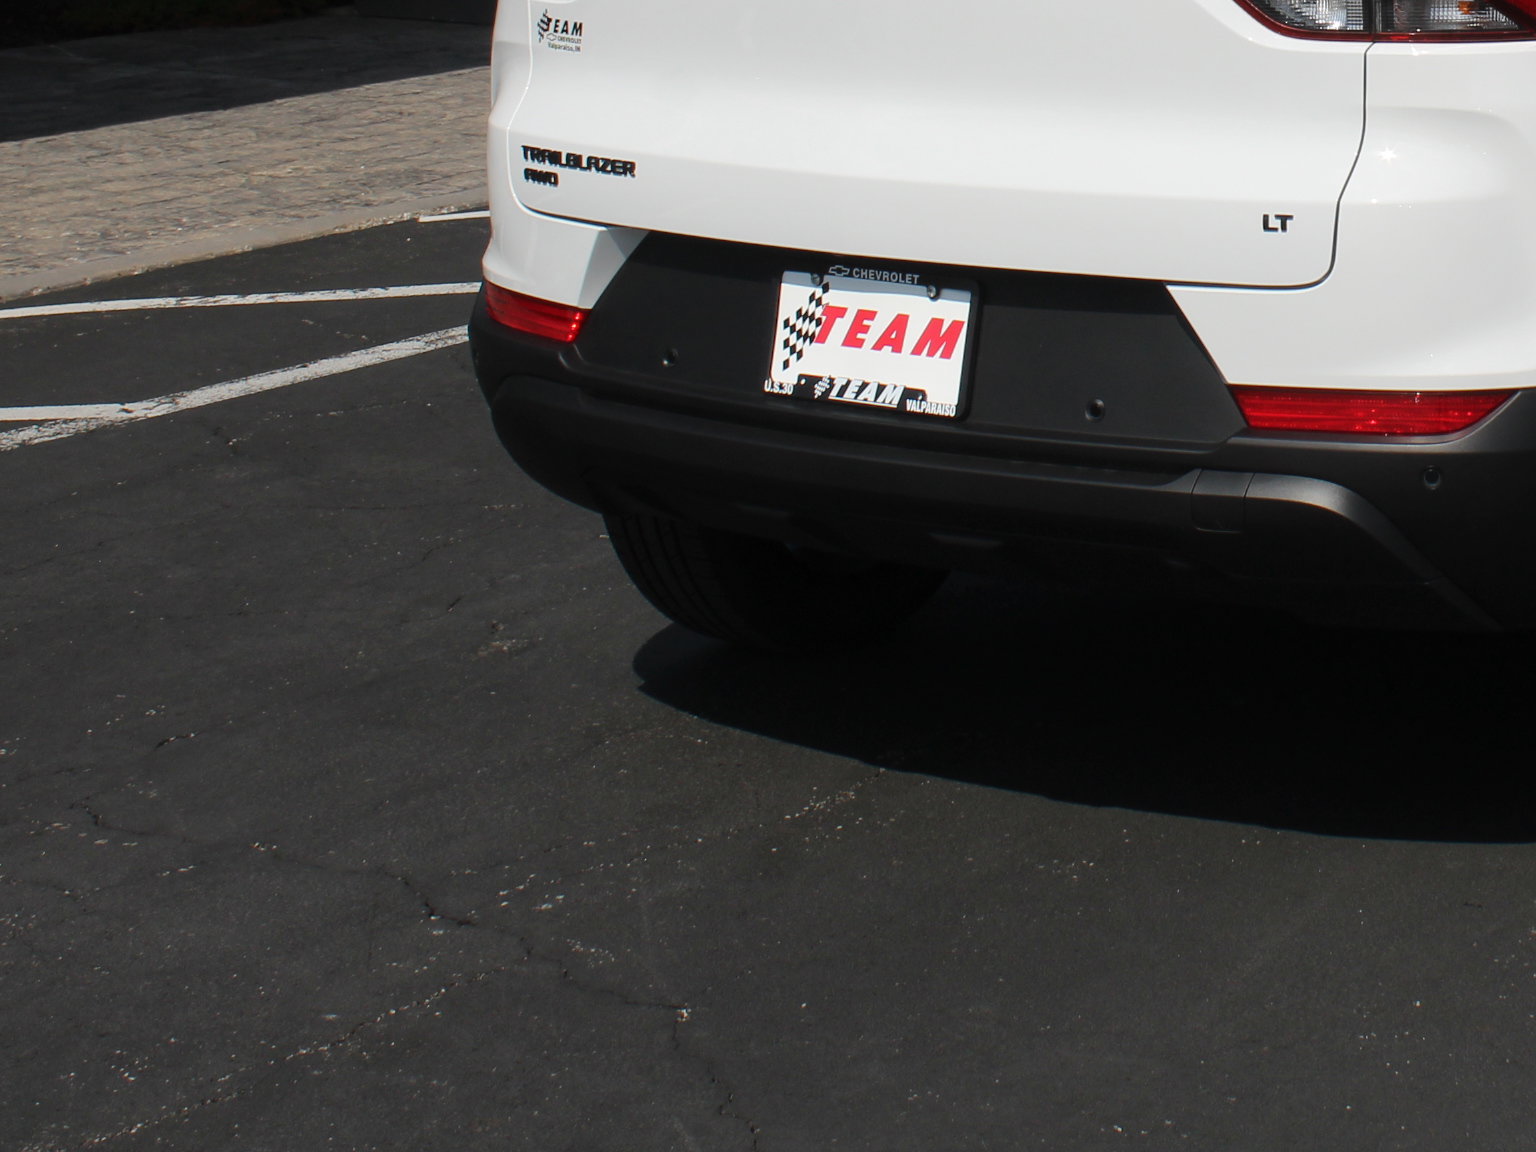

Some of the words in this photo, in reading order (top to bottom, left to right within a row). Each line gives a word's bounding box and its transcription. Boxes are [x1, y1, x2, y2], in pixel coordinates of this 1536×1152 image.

[544, 17, 583, 37] TEAM
[521, 145, 636, 177] TRAILBLAZER
[524, 168, 559, 187] AWD
[1262, 213, 1294, 232] LT
[852, 268, 920, 285] CHEVROLET
[814, 304, 966, 360] TEAM
[829, 377, 906, 406] TEAM
[906, 399, 957, 418] VALPARAISO
